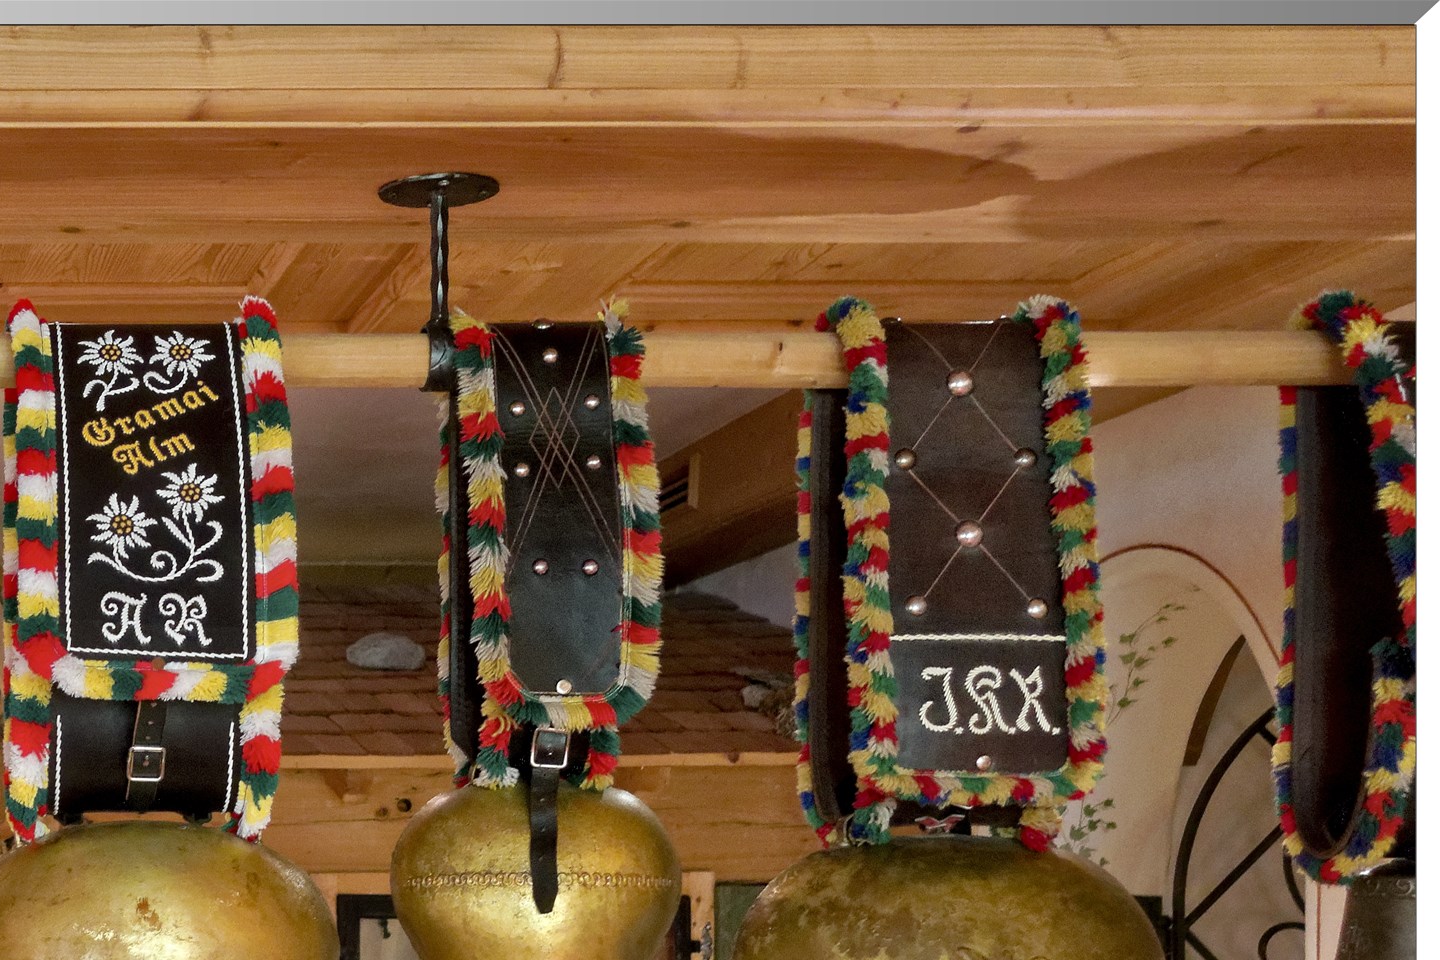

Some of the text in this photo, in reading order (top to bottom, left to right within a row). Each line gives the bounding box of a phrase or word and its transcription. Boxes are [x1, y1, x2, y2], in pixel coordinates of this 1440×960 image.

[82, 380, 220, 447] Gramai
[112, 433, 196, 475] Alm
[100, 591, 152, 644] A
